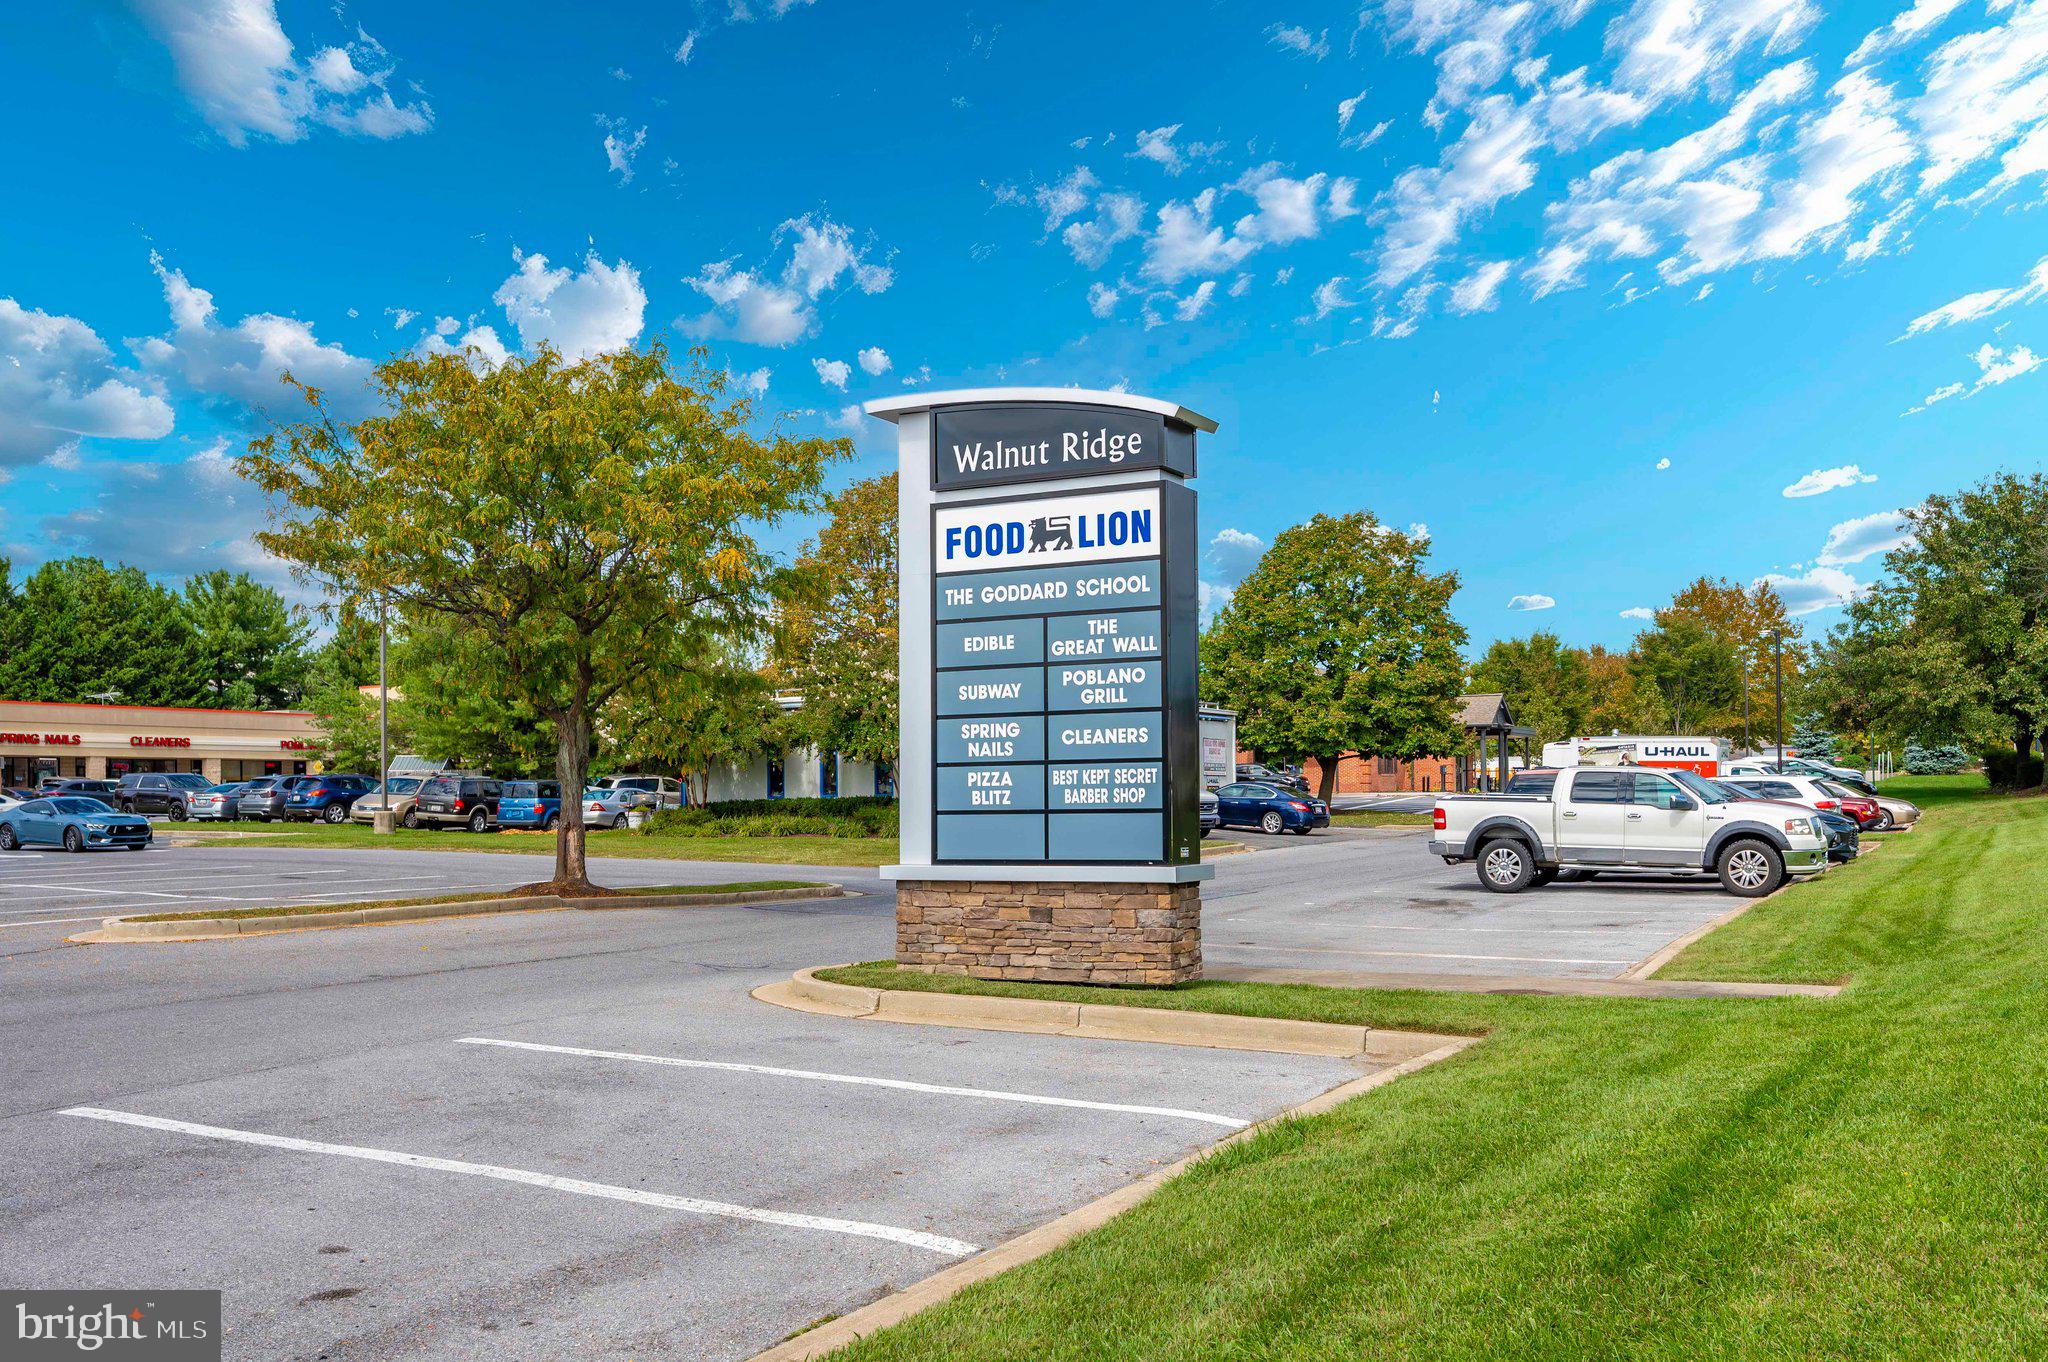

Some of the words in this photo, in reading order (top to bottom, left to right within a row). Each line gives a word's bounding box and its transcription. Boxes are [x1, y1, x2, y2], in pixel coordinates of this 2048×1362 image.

[952, 440, 1050, 473] Walnut
[1062, 428, 1142, 463] Ridge
[945, 521, 1025, 560] FOOD
[1078, 508, 1152, 549] LION
[945, 587, 974, 606] THE
[980, 581, 1068, 604] GODDARD
[1075, 574, 1151, 597] SCHOOL
[1087, 618, 1118, 636] THE
[963, 634, 1015, 652] EDIBLE
[1050, 638, 1105, 656] GREAT
[1112, 635, 1158, 653] WALL
[1062, 667, 1146, 687] POBLANO
[957, 683, 1022, 701] SUBWAY
[1080, 687, 1128, 705] GRILL
[0, 733, 40, 745] PRING
[44, 734, 82, 746] NAILS
[960, 722, 1021, 740] SPRING
[1061, 727, 1149, 746] CLEANERS
[130, 736, 191, 748] CLEANERS
[967, 741, 1014, 758] NAILS
[1644, 746, 1710, 757] U-HAUL
[967, 771, 1013, 787] PIZZA
[1052, 769, 1079, 786] BEST
[1082, 768, 1110, 785] KEPT
[1114, 767, 1158, 785] SECRET
[971, 789, 1011, 806] BLITZ
[1064, 788, 1109, 804] BARBER
[1112, 787, 1146, 804] SHOP
